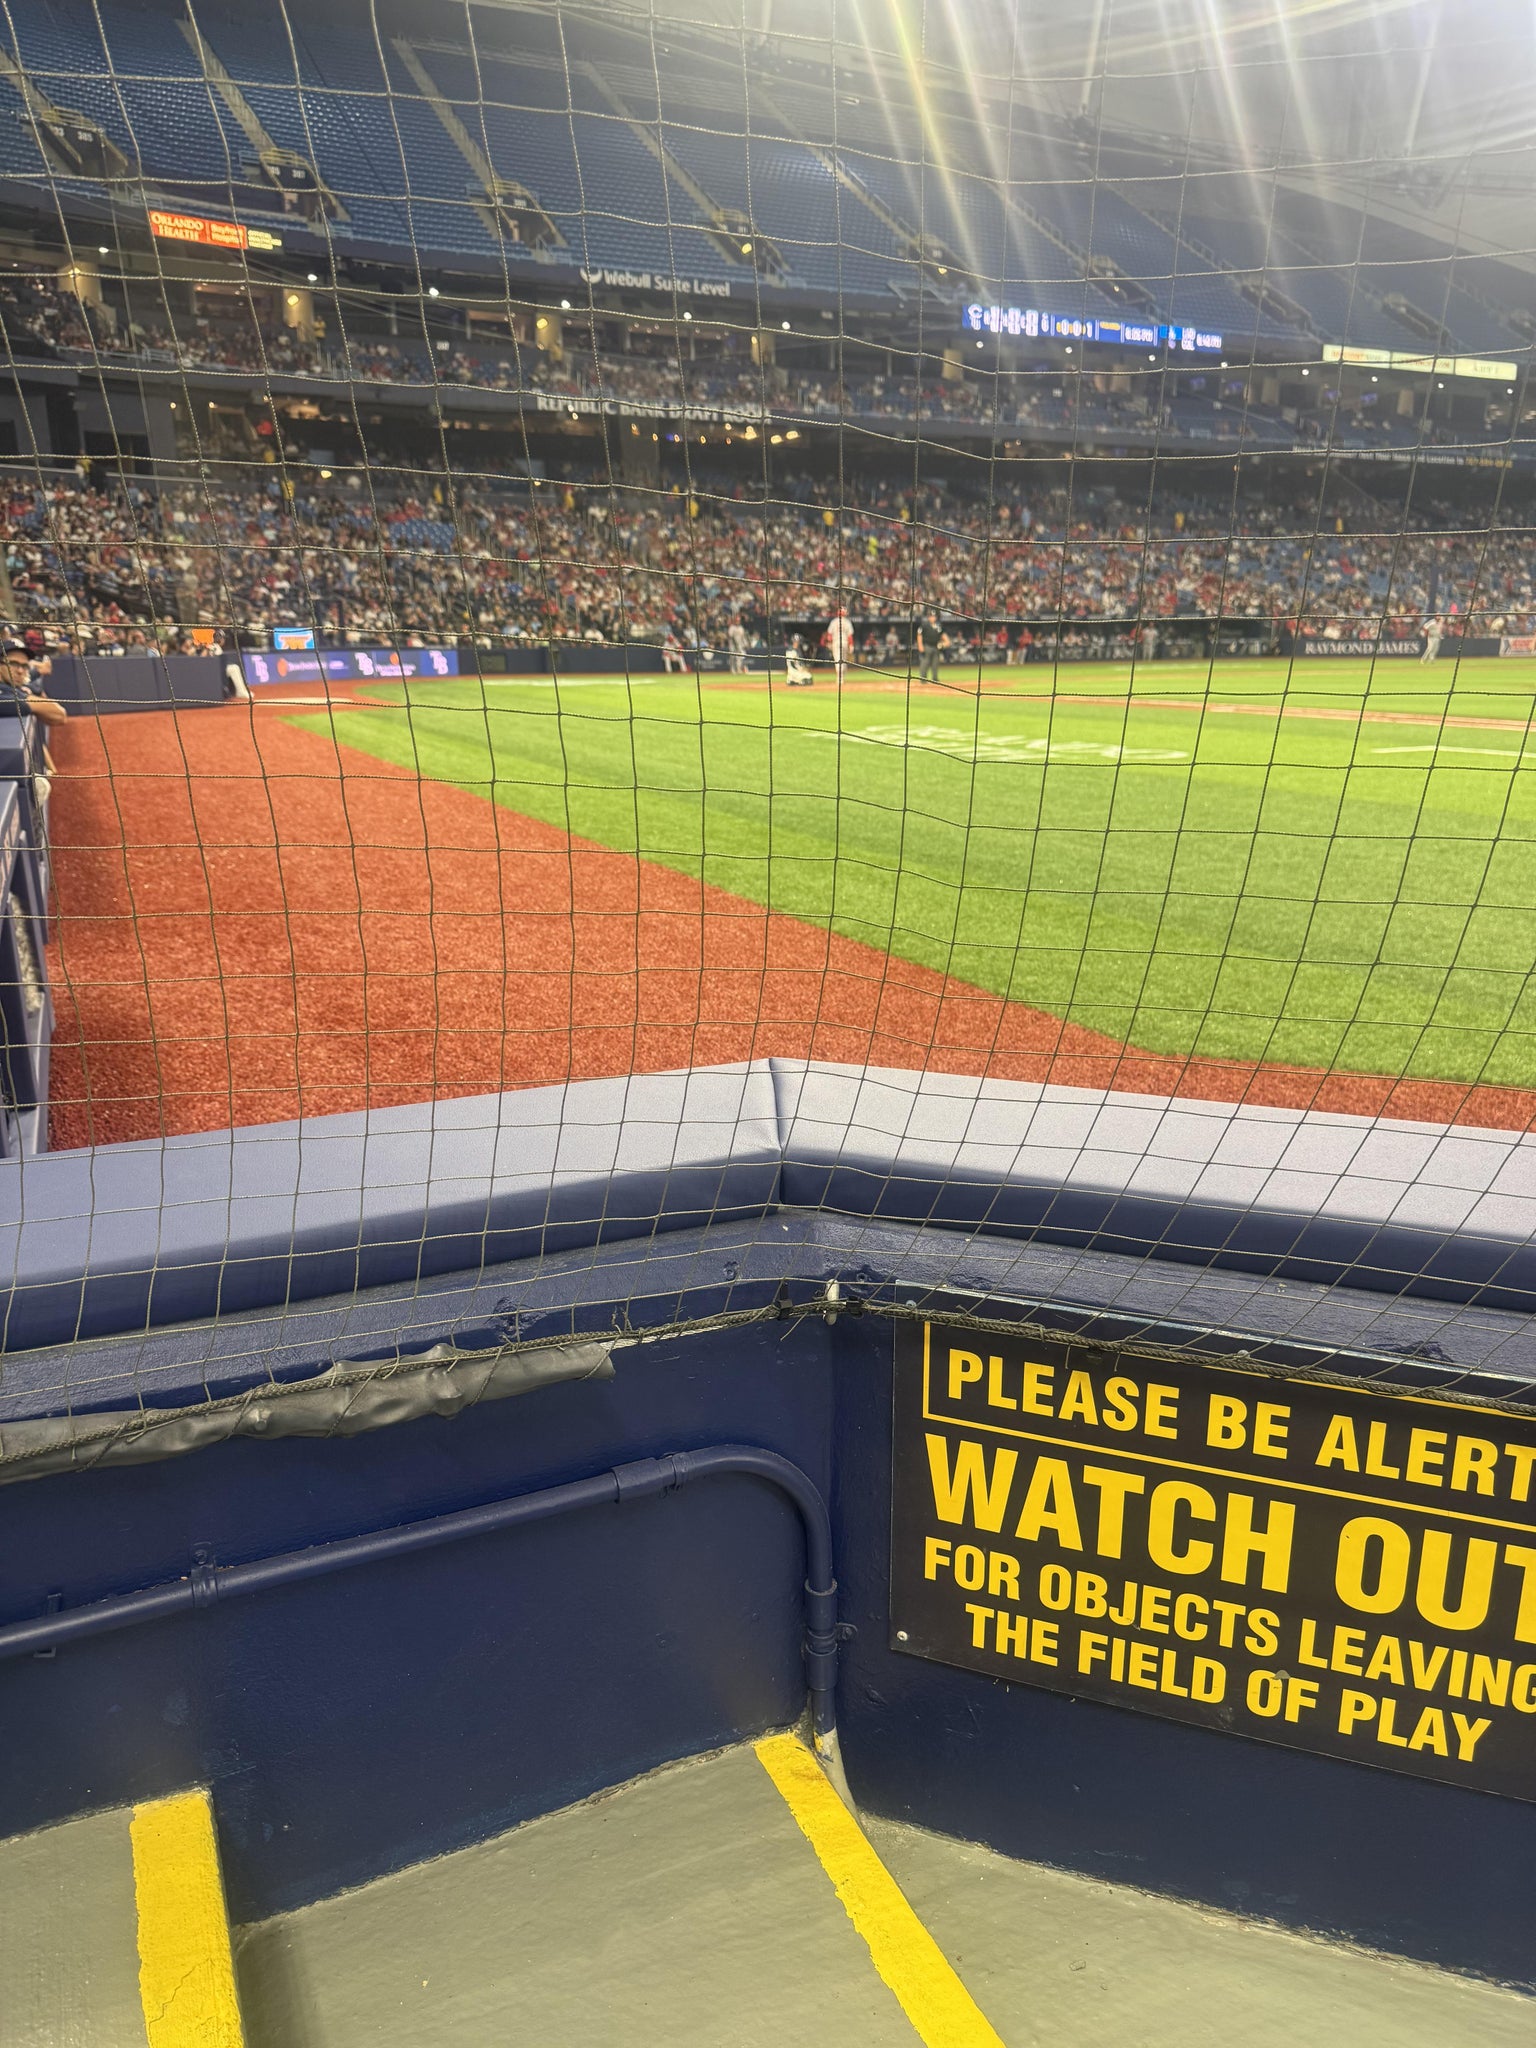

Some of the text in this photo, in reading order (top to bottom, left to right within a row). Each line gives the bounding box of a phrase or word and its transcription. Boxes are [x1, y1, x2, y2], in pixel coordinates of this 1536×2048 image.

[151, 212, 204, 231] ORLANDO
[159, 224, 199, 241] HEALTH
[604, 270, 731, 297] Webull Suite Level
[537, 396, 617, 415] REPUBLIC
[620, 402, 664, 418] BANK
[1305, 640, 1420, 655] RAYMOND JAMES
[948, 1348, 1536, 1502] PLEASE BE ALERT
[925, 1433, 1296, 1594] WATCH
[924, 1536, 1536, 1714] FOR OBJECTS LEAVING
[965, 1603, 1493, 1763] THE FIELD OF PLAY
